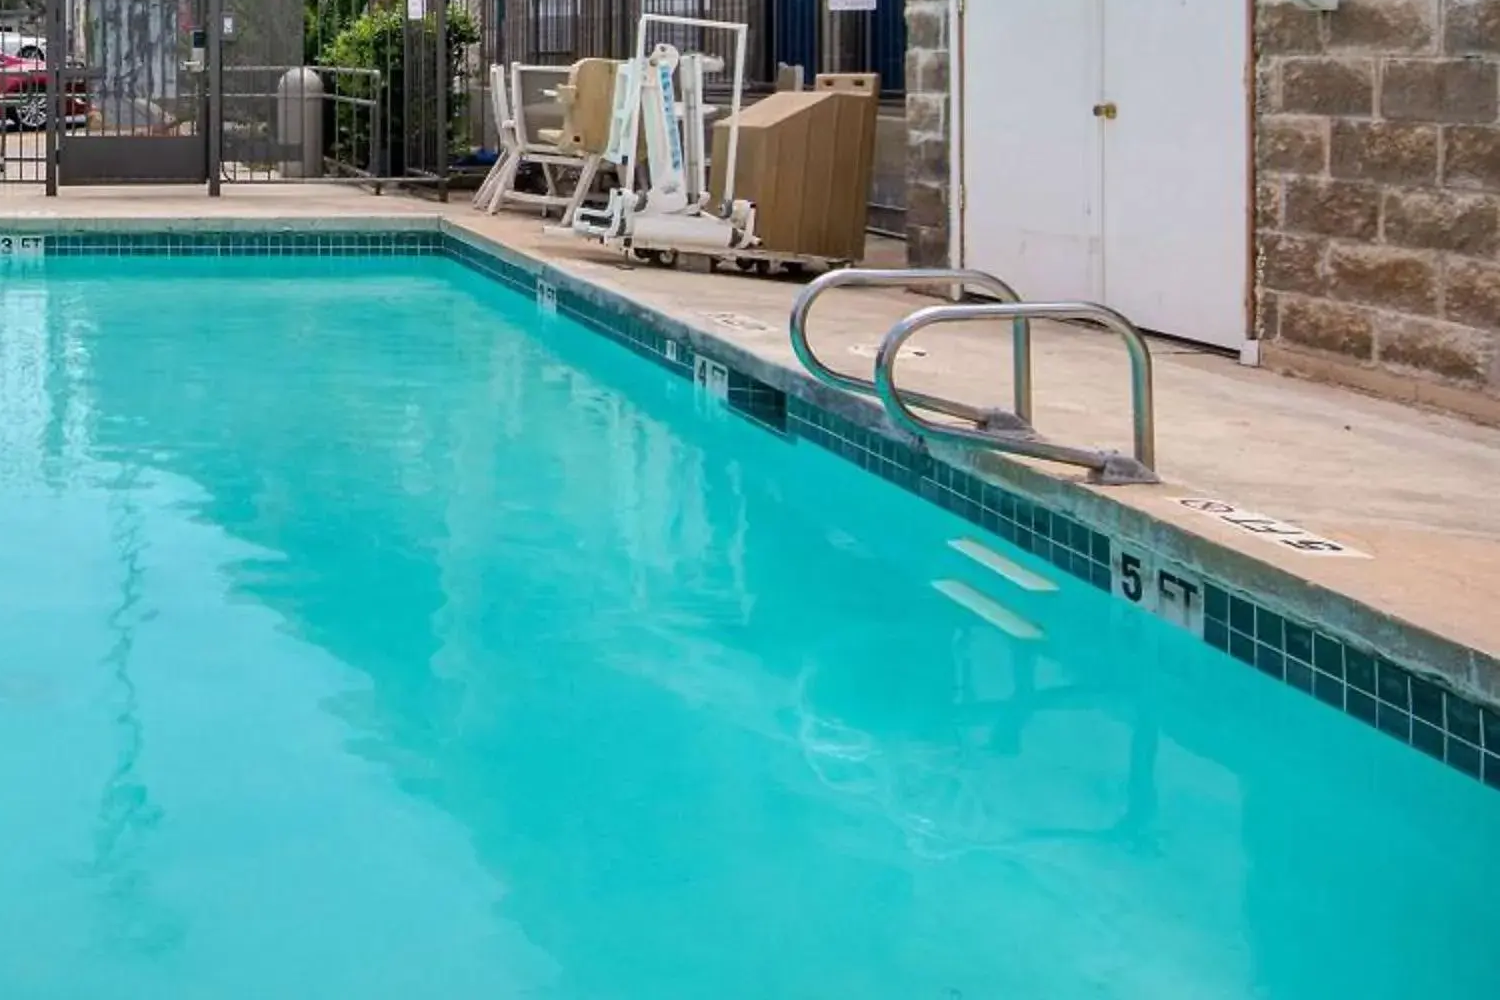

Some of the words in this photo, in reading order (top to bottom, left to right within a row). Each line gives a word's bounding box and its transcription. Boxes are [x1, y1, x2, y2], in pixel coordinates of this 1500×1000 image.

[1, 237, 13, 255] 3
[697, 359, 707, 389] 4
[1121, 551, 1142, 603] 5
[1158, 568, 1198, 609] FT
